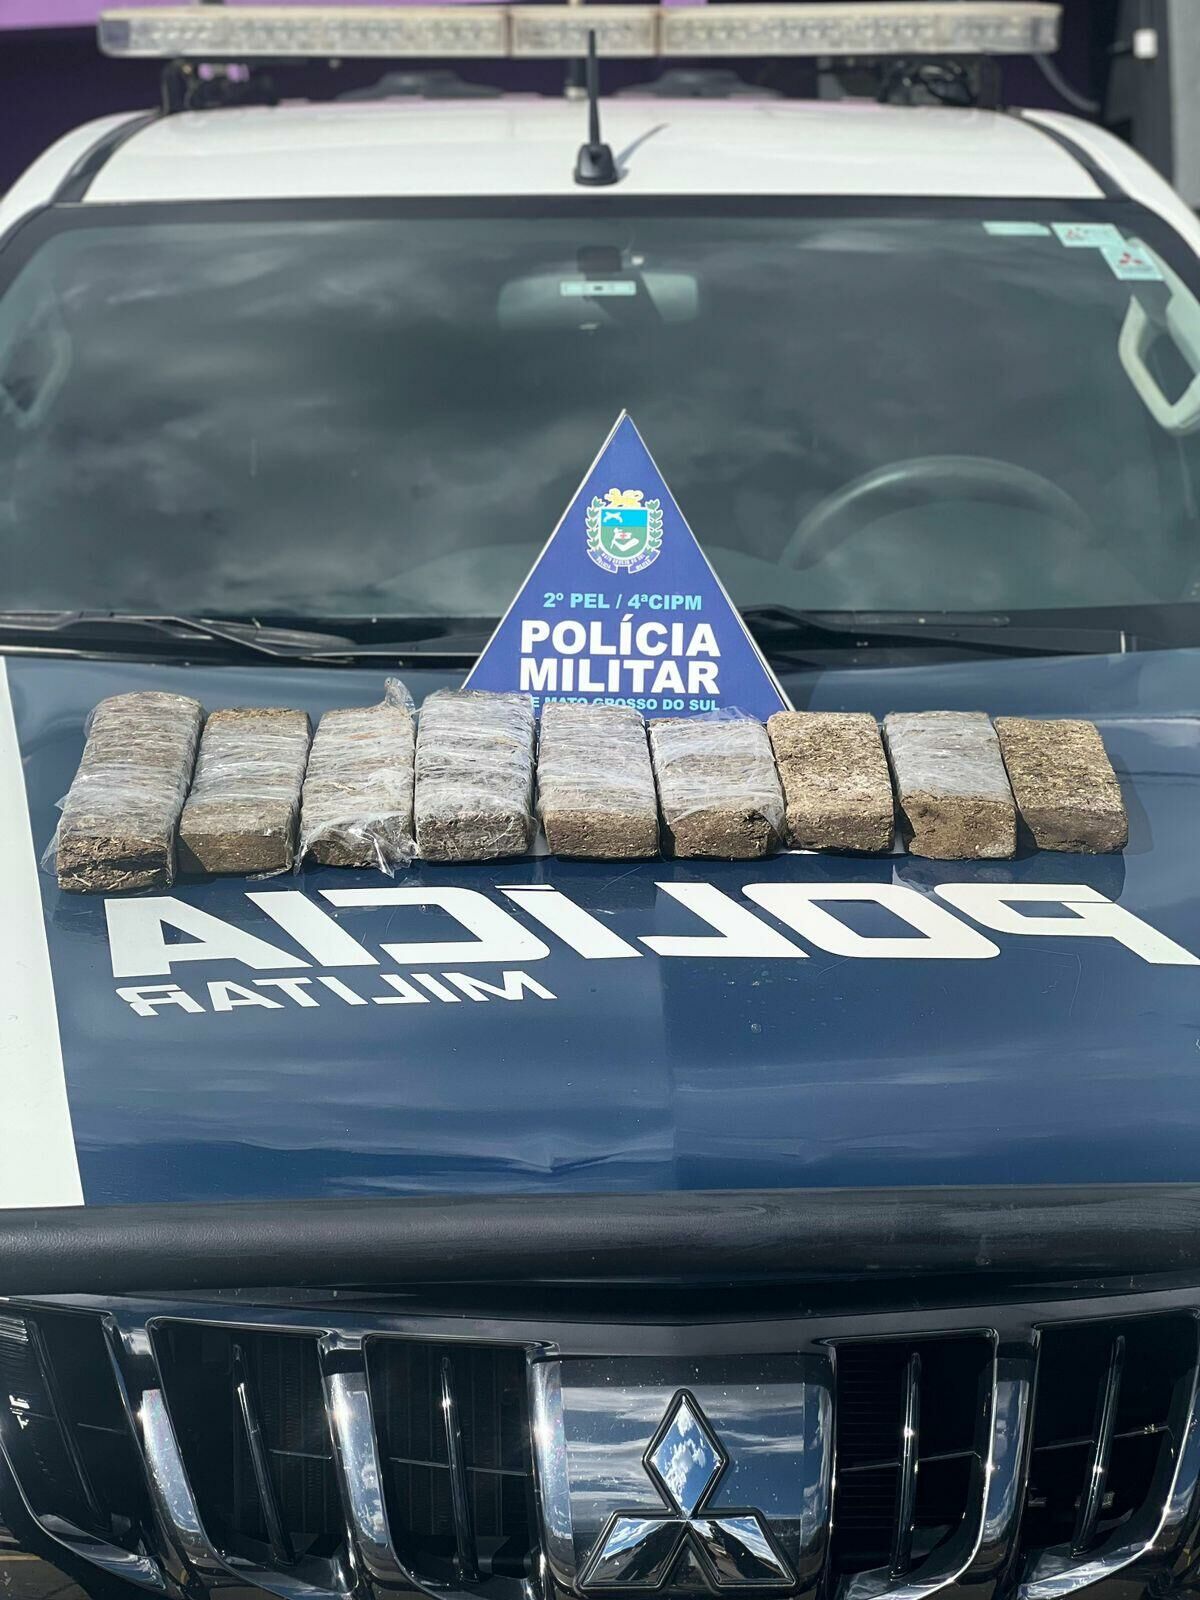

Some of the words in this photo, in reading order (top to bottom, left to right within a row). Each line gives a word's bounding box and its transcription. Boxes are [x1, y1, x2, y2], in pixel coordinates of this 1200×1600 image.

[543, 592, 564, 608] 2º
[570, 593, 610, 609] PEL
[615, 594, 622, 609] /
[627, 593, 702, 610] 4ªCIPM
[520, 613, 721, 657] POLÍCIA
[519, 658, 720, 694] MILITAR
[662, 699, 684, 710] DO
[689, 699, 720, 711] SUL
